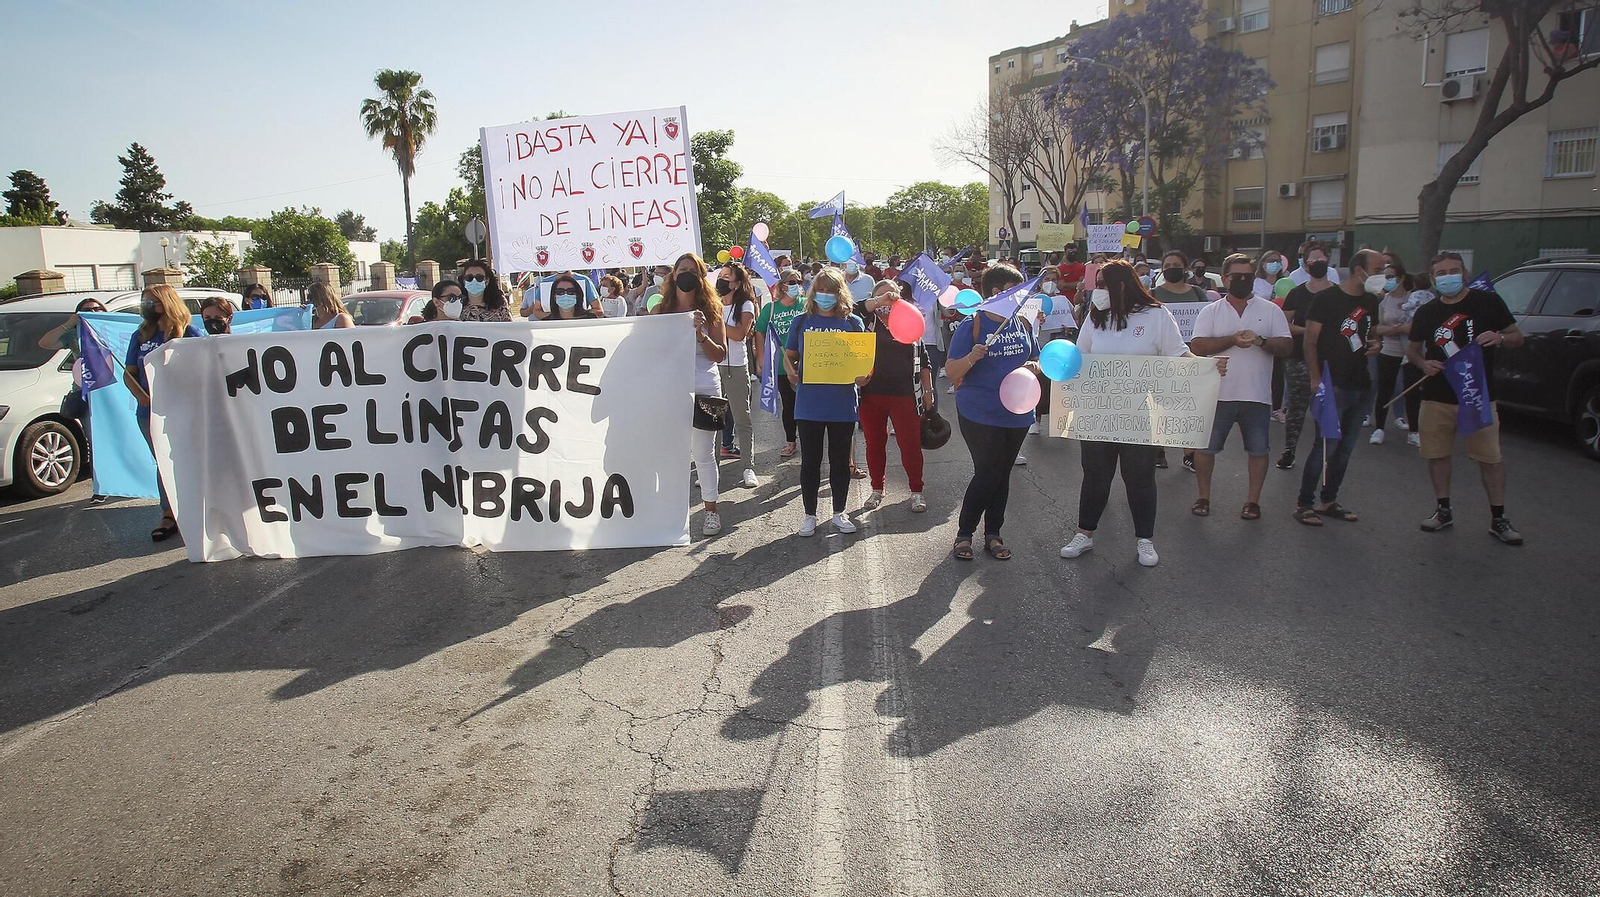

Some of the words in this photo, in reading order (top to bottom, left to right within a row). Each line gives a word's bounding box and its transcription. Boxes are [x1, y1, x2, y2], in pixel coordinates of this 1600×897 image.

[505, 123, 597, 163] ¡BASTA
[612, 116, 660, 148] YA!
[499, 173, 543, 210] ¡NO
[551, 167, 585, 198] AL
[591, 152, 688, 189] CIERRE
[540, 210, 571, 237] DE
[588, 196, 689, 231] LÍNEAS!
[809, 338, 831, 347] LOS
[835, 338, 867, 347] NIÑOS
[225, 345, 298, 398] NO
[318, 340, 387, 388] AL
[401, 333, 607, 395] CIERRE
[1089, 360, 1131, 379] AMPA
[1138, 360, 1200, 379] AGORA
[1110, 379, 1164, 395] ISABEL
[1170, 379, 1191, 394] LA
[1137, 394, 1197, 412] APOYA
[270, 403, 352, 453] DE
[1100, 413, 1152, 433] ANTONIO
[251, 474, 325, 523] EN
[334, 472, 408, 518] EL
